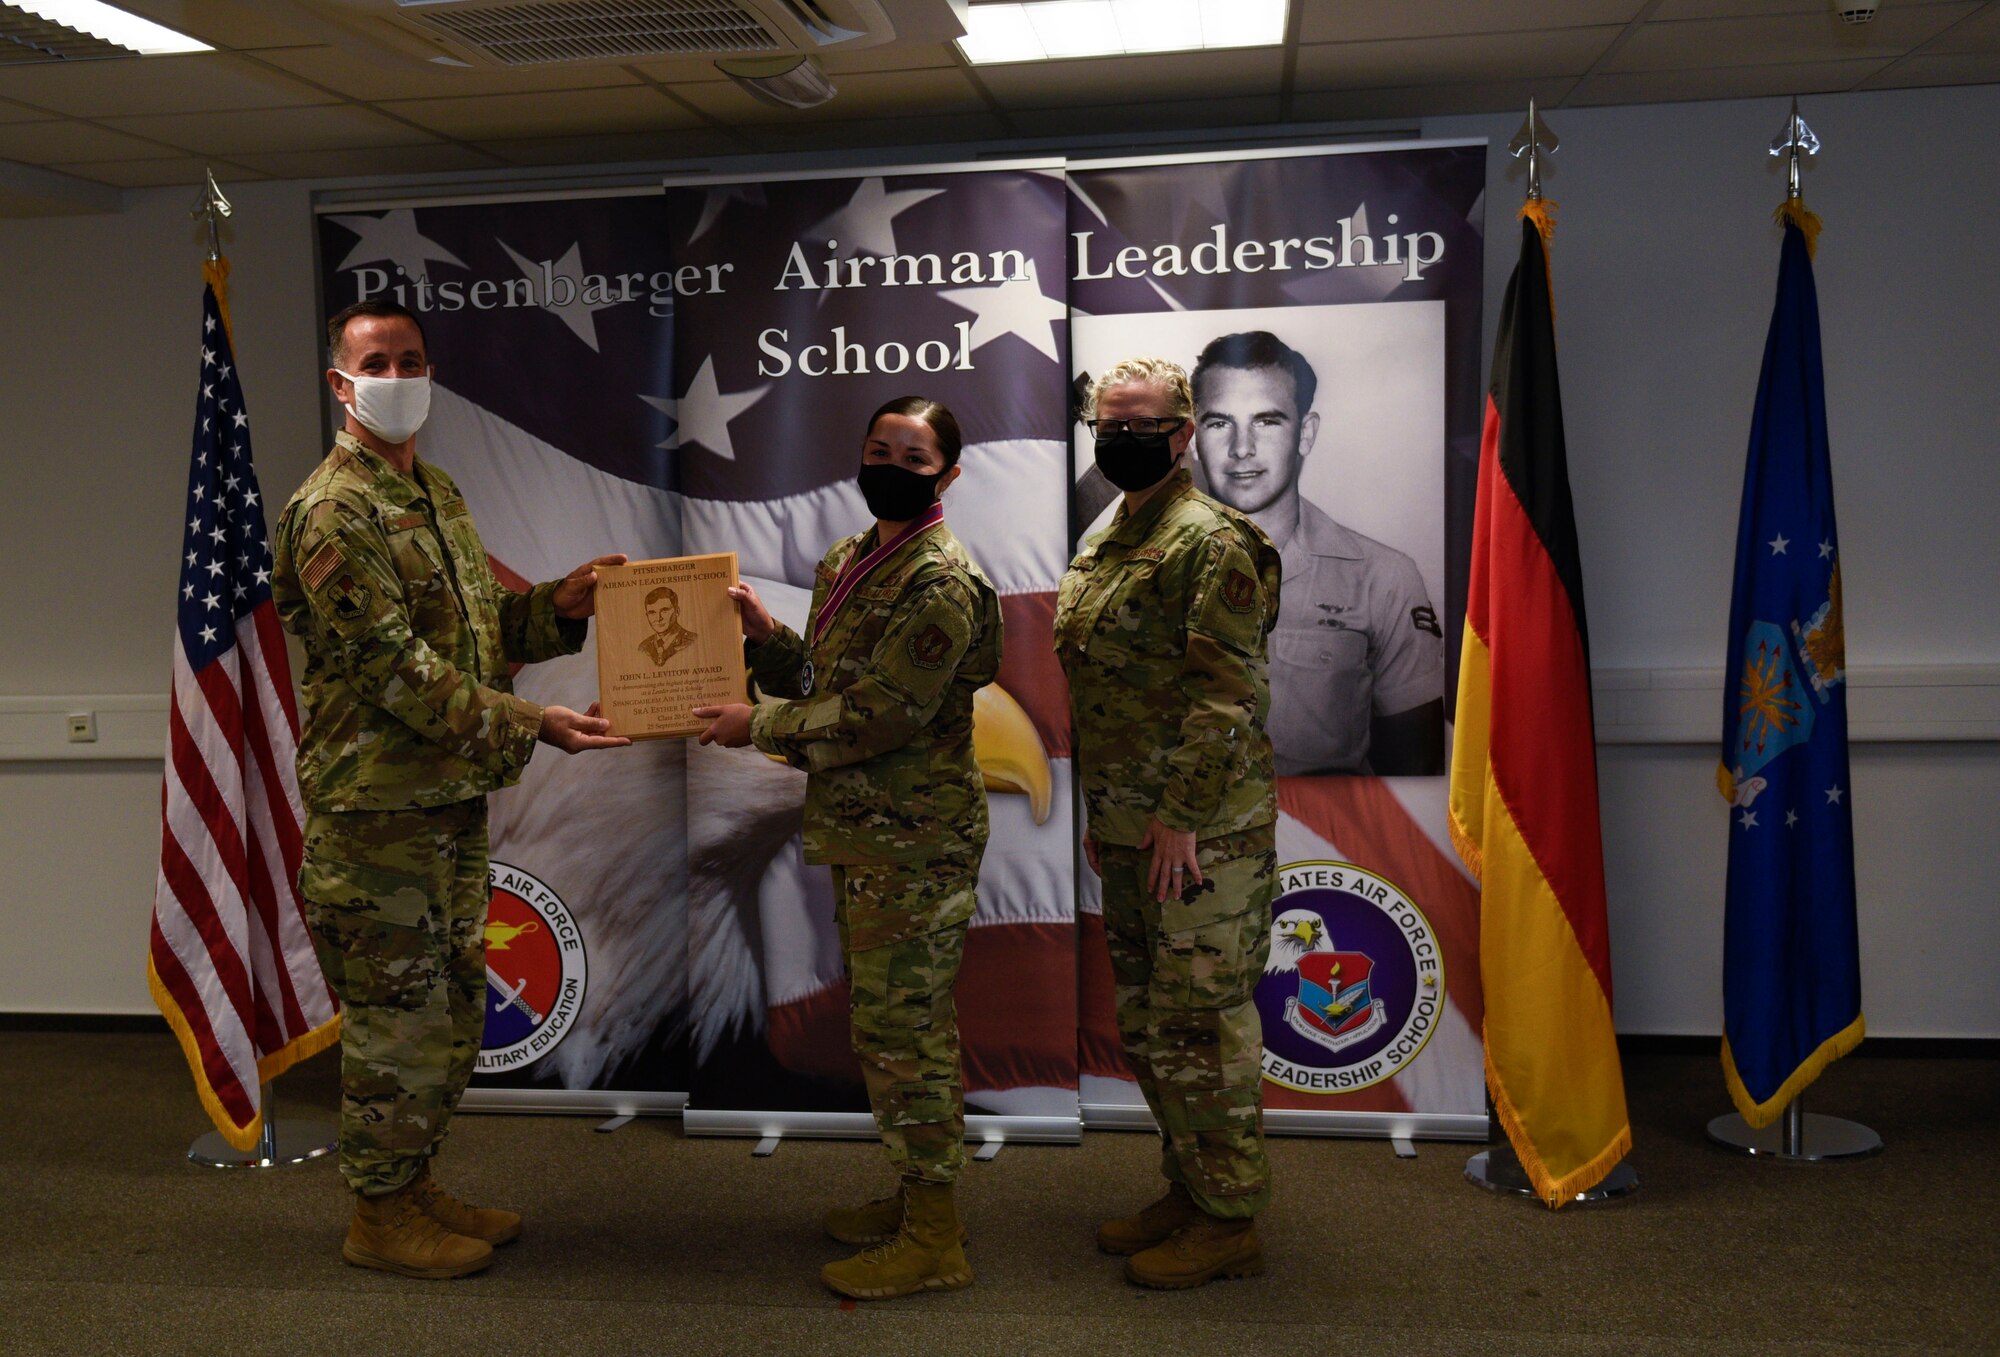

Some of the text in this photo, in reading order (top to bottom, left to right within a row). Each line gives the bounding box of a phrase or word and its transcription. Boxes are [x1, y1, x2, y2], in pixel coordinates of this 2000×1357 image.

[352, 214, 1445, 317] Pitsenbarger Airman Leadership
[758, 321, 975, 377] School
[602, 571, 729, 590] AIRMAN LEADERSHIP SCHOOL
[633, 563, 696, 575] PITSENBARGER
[619, 673, 642, 682] JOHN
[652, 668, 690, 679] LEVITOW
[692, 665, 723, 676] AWARD
[655, 721, 685, 730] September
[686, 719, 700, 727] 2020
[502, 873, 578, 952] AIR FORCE
[1280, 871, 1437, 972] TATES AIR FORCE
[475, 978, 579, 1067] ILITARY EDUCATION
[1386, 990, 1438, 1065] SCHOOL
